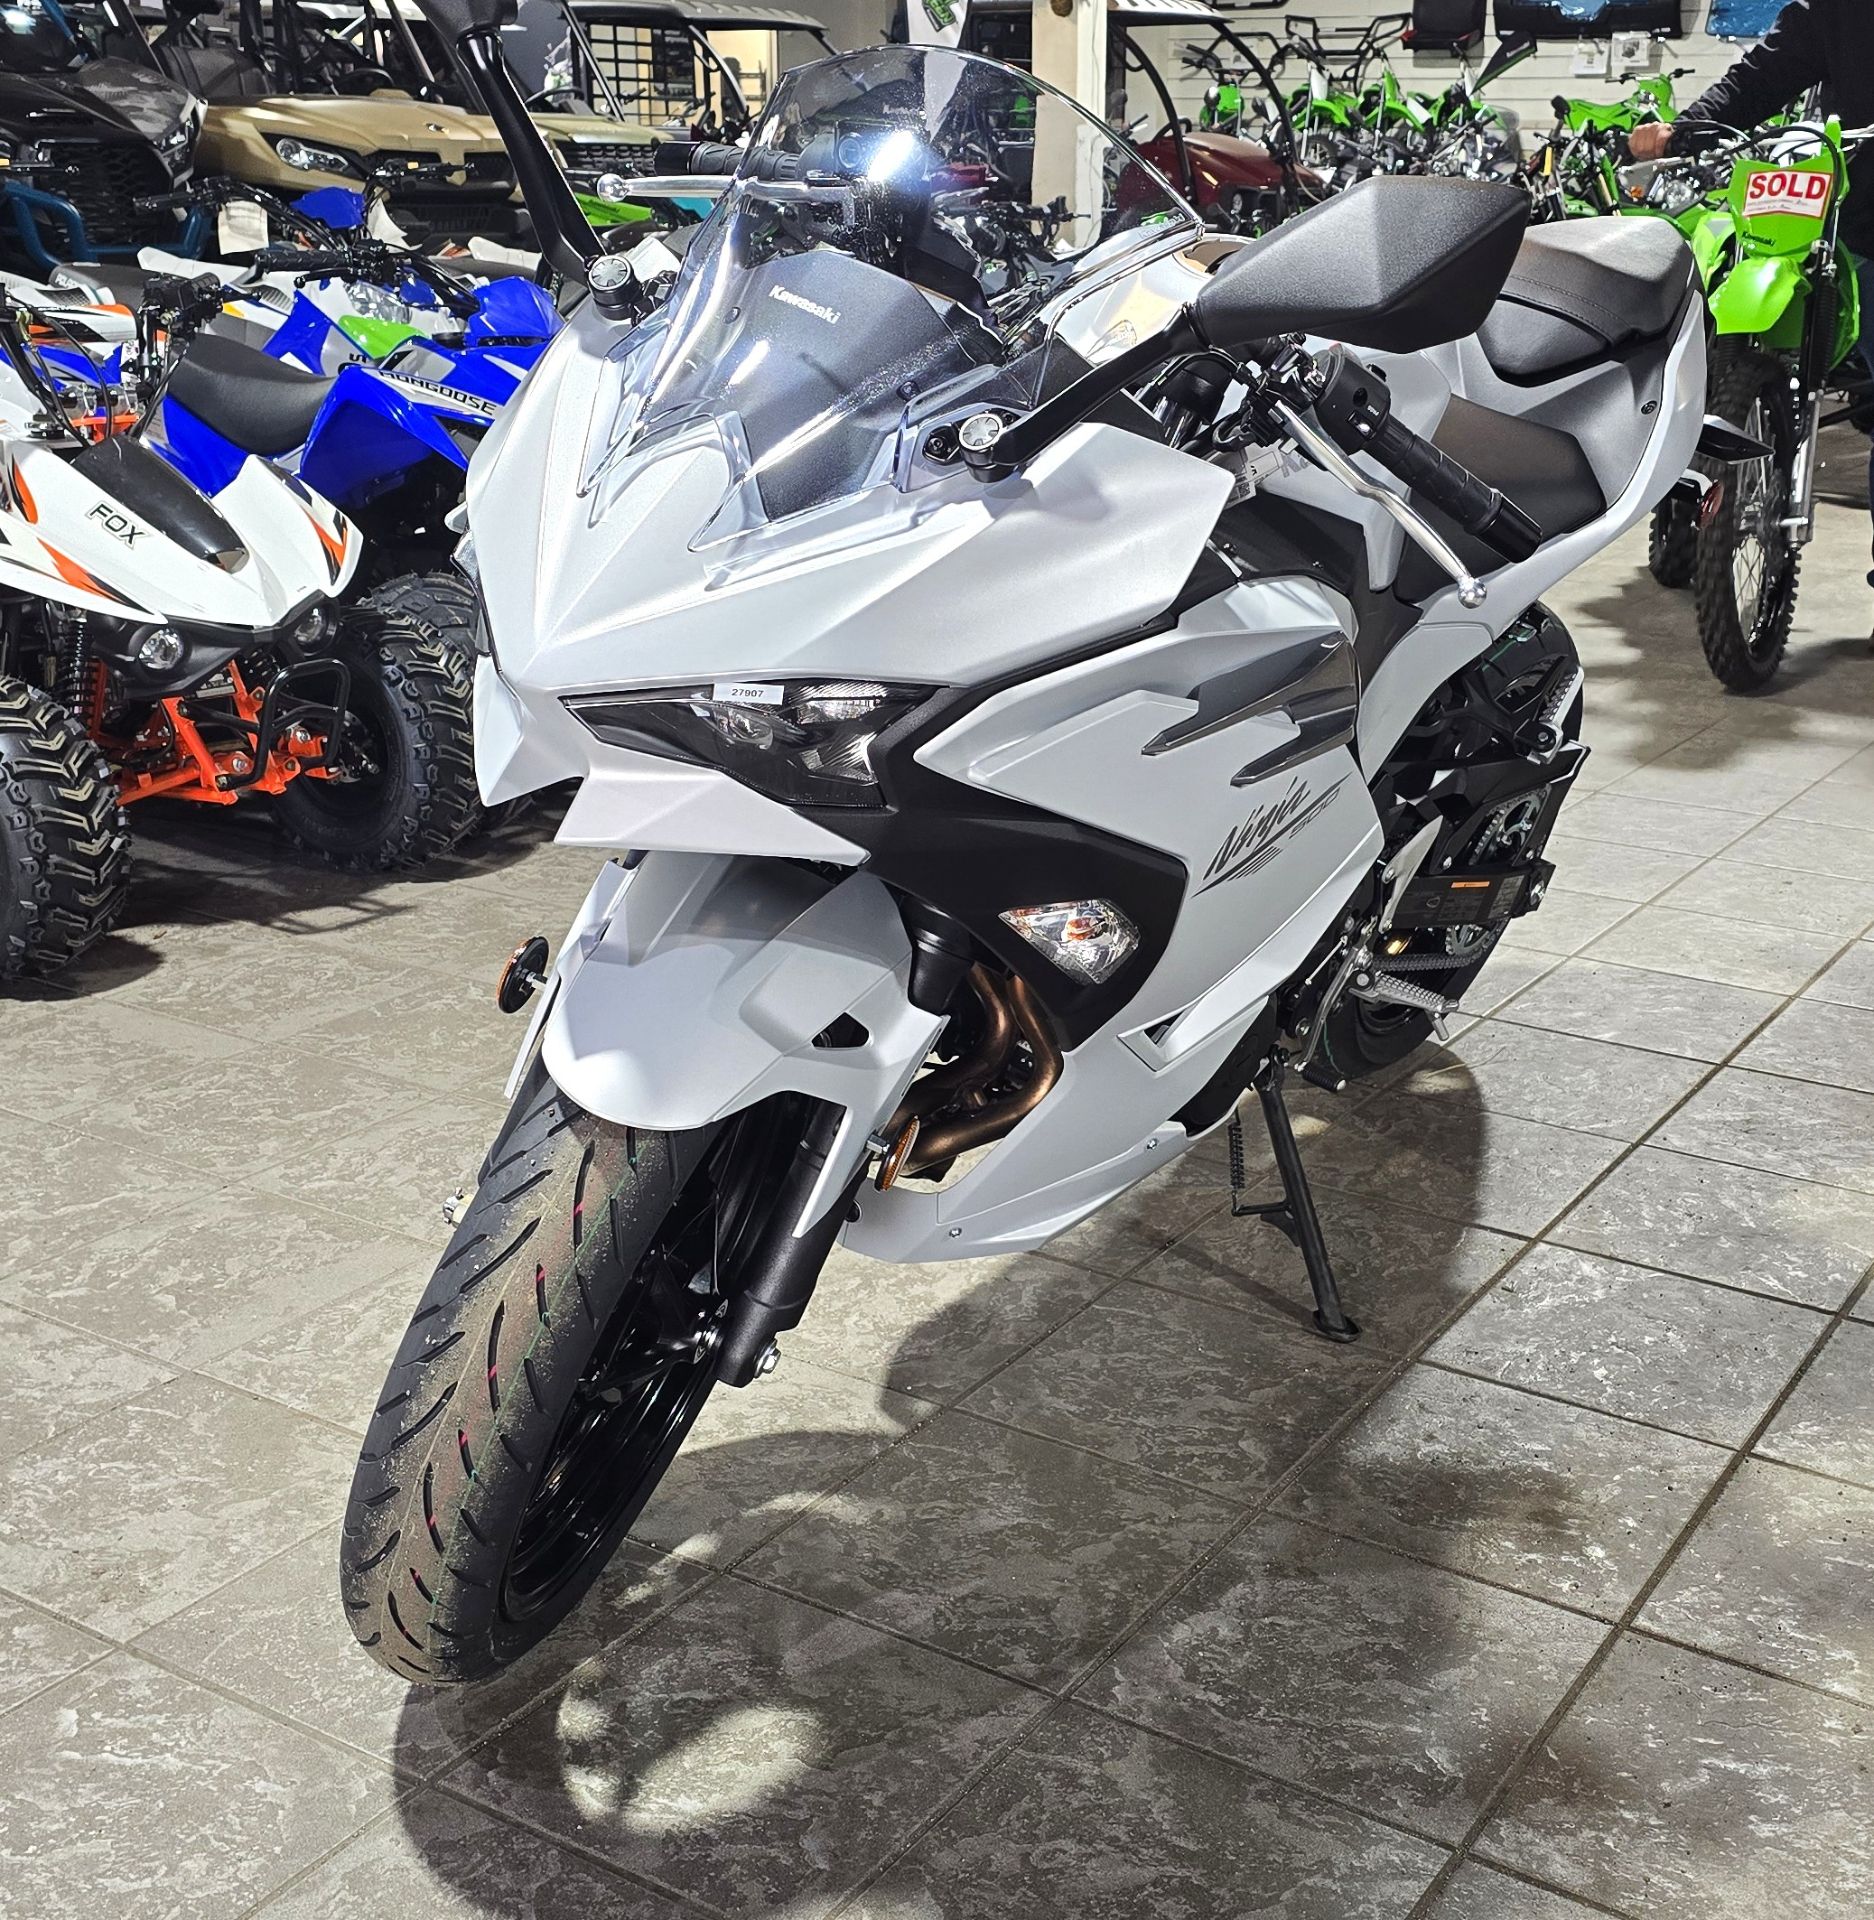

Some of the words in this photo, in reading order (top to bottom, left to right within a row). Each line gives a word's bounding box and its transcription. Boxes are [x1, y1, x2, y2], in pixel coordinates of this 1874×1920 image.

[1749, 173, 1826, 200] SOLD
[768, 284, 842, 325] Kawasaki
[89, 503, 147, 546] FOX
[731, 688, 765, 698] 27907
[1202, 776, 1312, 882] Ninja
